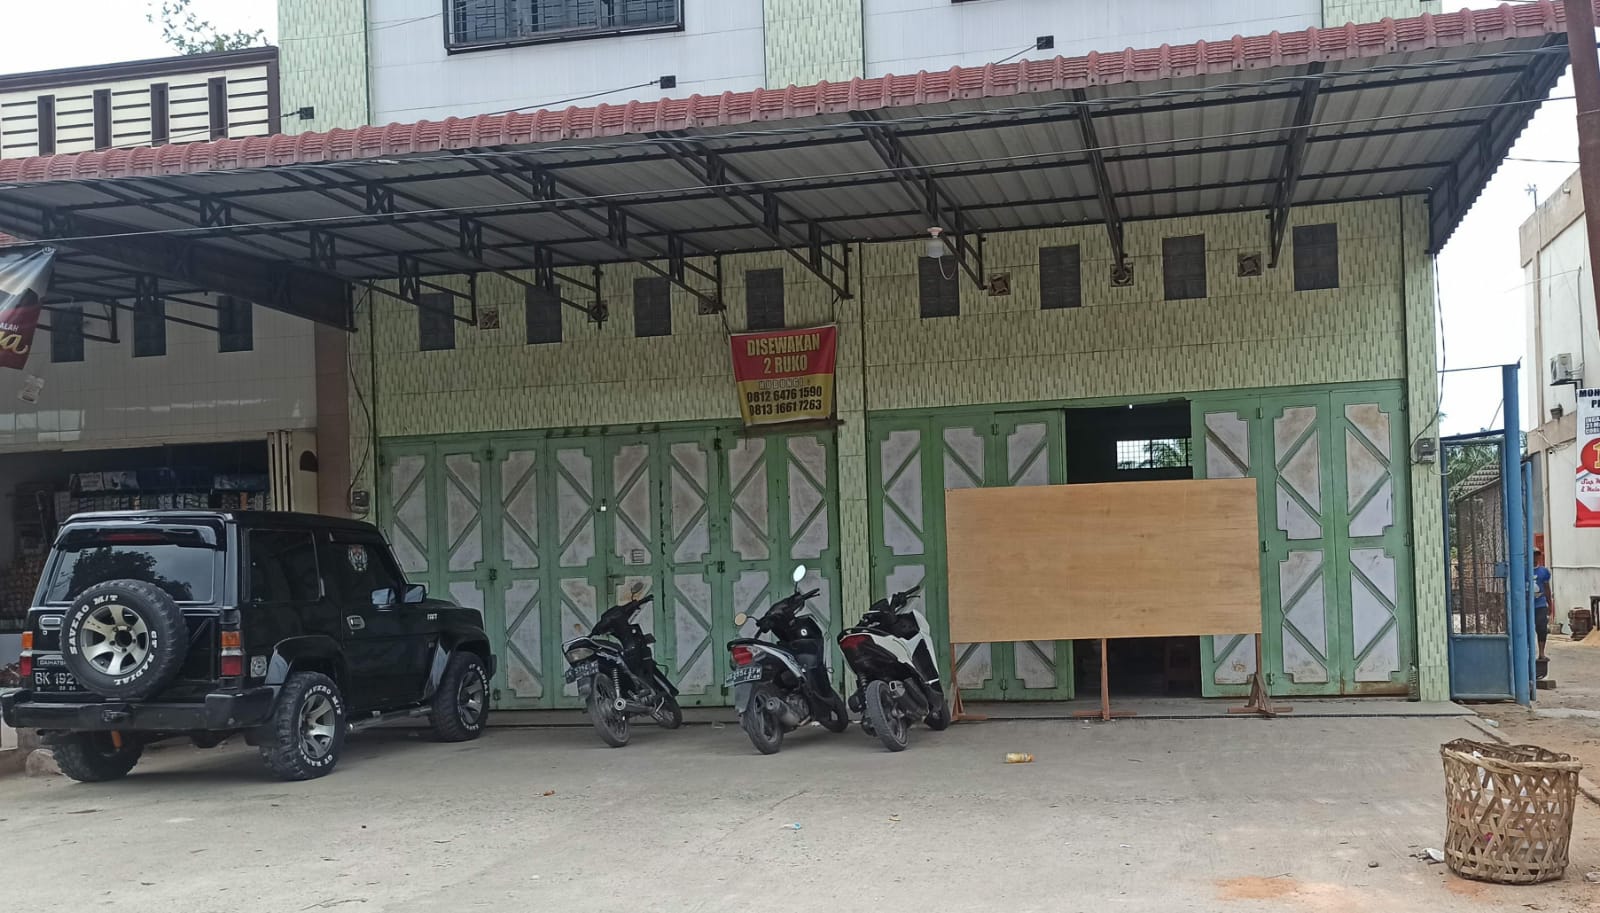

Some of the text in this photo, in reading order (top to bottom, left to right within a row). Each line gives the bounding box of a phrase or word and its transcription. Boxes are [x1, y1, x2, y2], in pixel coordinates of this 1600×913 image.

[747, 334, 820, 356] DISEWAKAN
[764, 354, 808, 374] 2 RUKO
[759, 378, 804, 390] HUBUNGI
[746, 386, 822, 403] 0812 6476 1590
[749, 399, 822, 416] 0813 1661 7263
[69, 595, 118, 655] SAVERO M/T
[114, 630, 157, 686] GT RADIAL
[35, 672, 80, 685] BK 192
